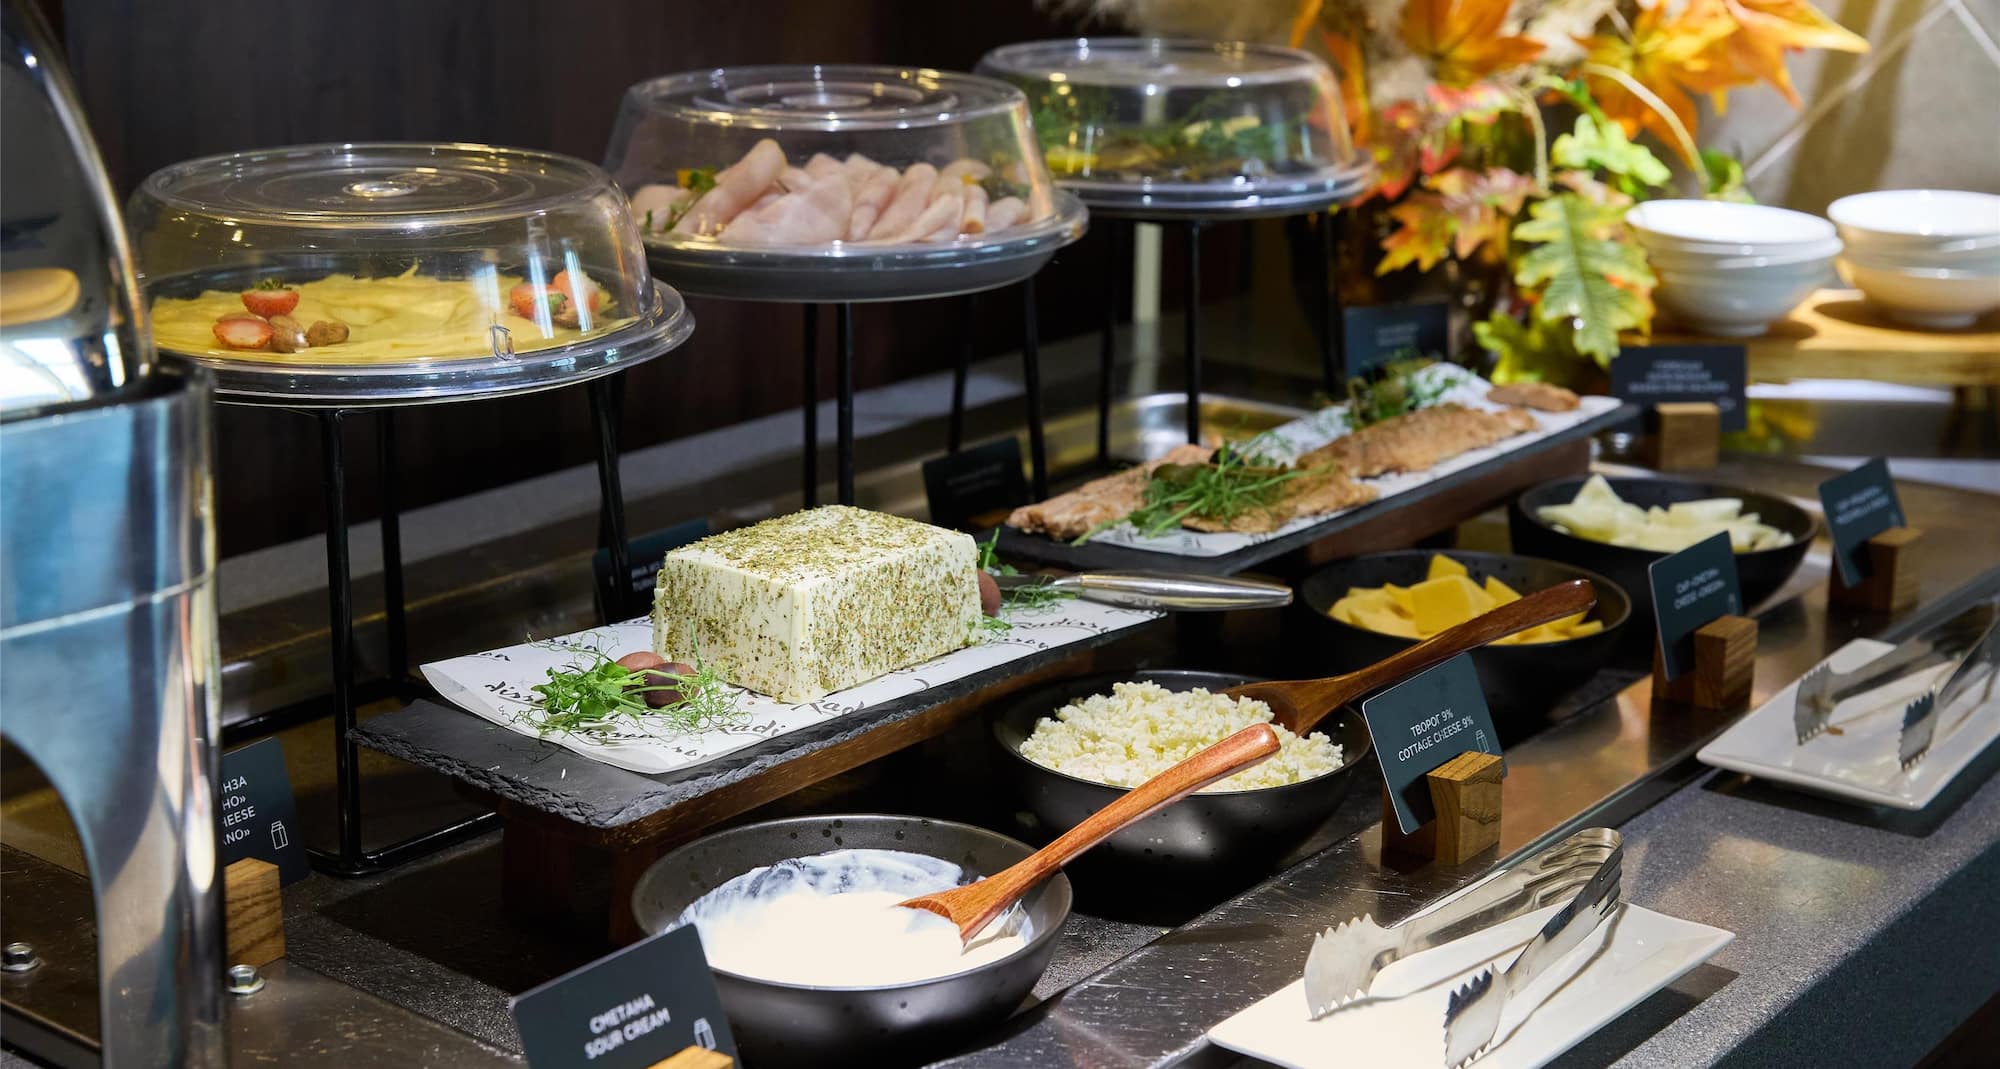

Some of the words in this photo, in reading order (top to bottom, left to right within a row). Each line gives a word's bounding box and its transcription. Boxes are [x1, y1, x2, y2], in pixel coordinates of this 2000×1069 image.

[1410, 714, 1440, 737] ТВОРОГ
[1441, 708, 1454, 722] 9%
[1398, 736, 1433, 762] COTTAGE
[1433, 720, 1463, 743] CHEESE
[1462, 715, 1474, 729] 9%
[222, 775, 247, 793] НЗА
[224, 829, 250, 845] NO»
[584, 1028, 624, 1060] SOUR
[623, 1007, 671, 1041] CREAM
